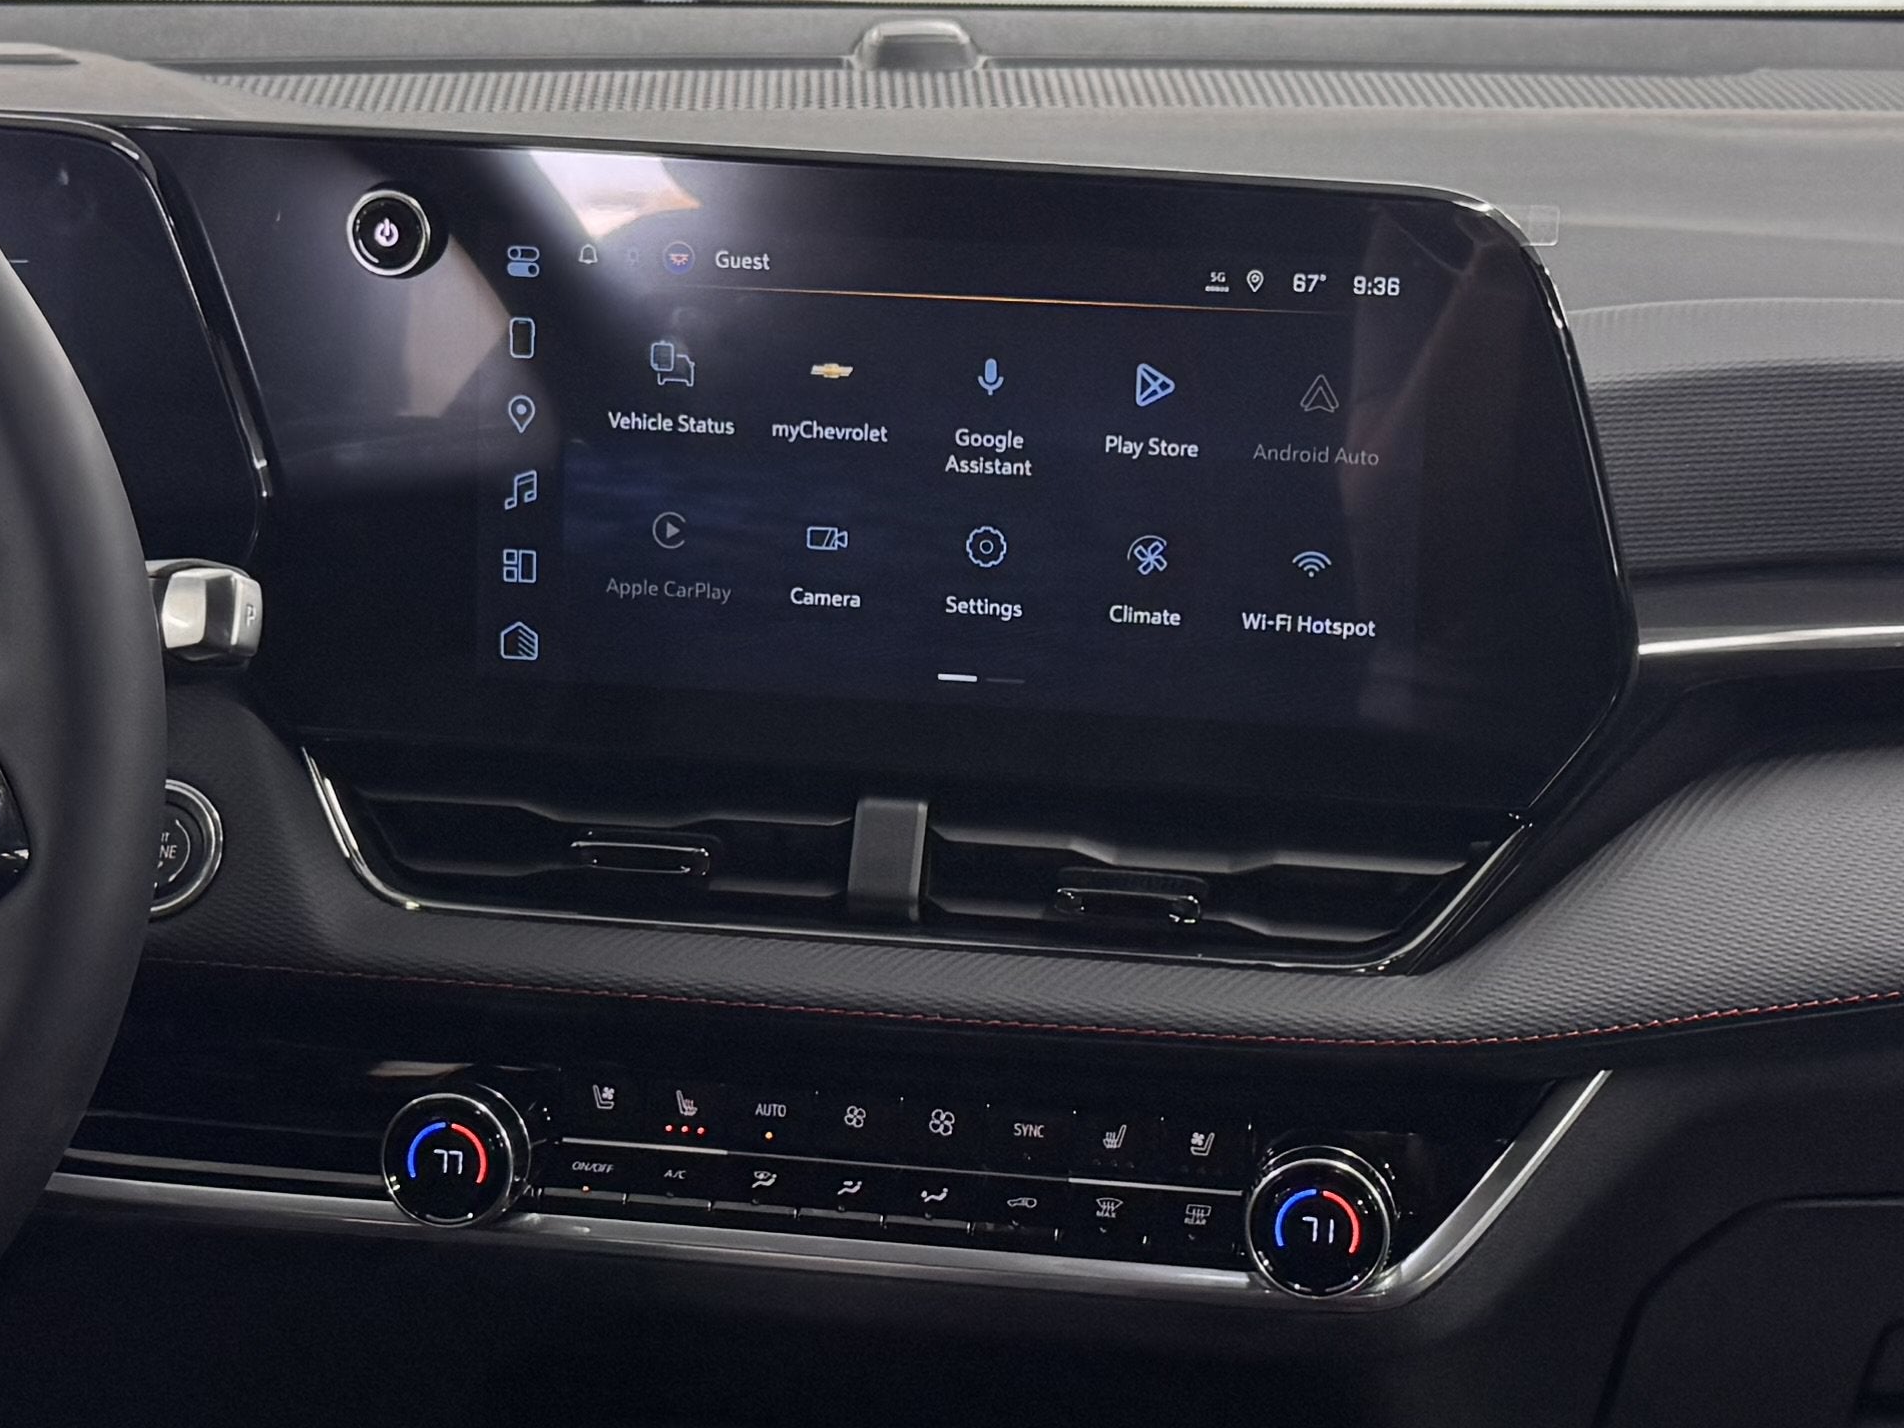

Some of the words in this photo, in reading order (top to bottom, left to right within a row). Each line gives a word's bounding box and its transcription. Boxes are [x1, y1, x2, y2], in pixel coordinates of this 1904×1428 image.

[715, 250, 771, 271] Guest
[1210, 271, 1226, 283] 5G
[1292, 273, 1327, 294] 67°
[1352, 275, 1401, 297] 9:36
[608, 411, 673, 432] Vehicle
[678, 414, 735, 435] Status
[772, 420, 888, 443] myChevrolet
[954, 428, 1024, 451] Google
[1104, 435, 1144, 460] Play
[1147, 437, 1199, 459] Store
[944, 454, 1033, 478] Assistant
[1252, 444, 1329, 464] Android
[1334, 447, 1380, 467] Auto
[605, 577, 659, 599] Apple
[663, 580, 732, 604] CarPlay
[789, 586, 862, 609] Camera
[944, 596, 1023, 622] Settings
[1109, 605, 1182, 626] Climate
[1241, 612, 1293, 633] Wi-Fi
[1296, 616, 1376, 640] Hotspot
[755, 1103, 787, 1118] AUTO
[1013, 1122, 1045, 1138] SYNC
[434, 1148, 464, 1175] 77
[572, 1160, 615, 1174] ON/OFF
[663, 1169, 688, 1180] A/C
[1302, 1216, 1335, 1244] 71
